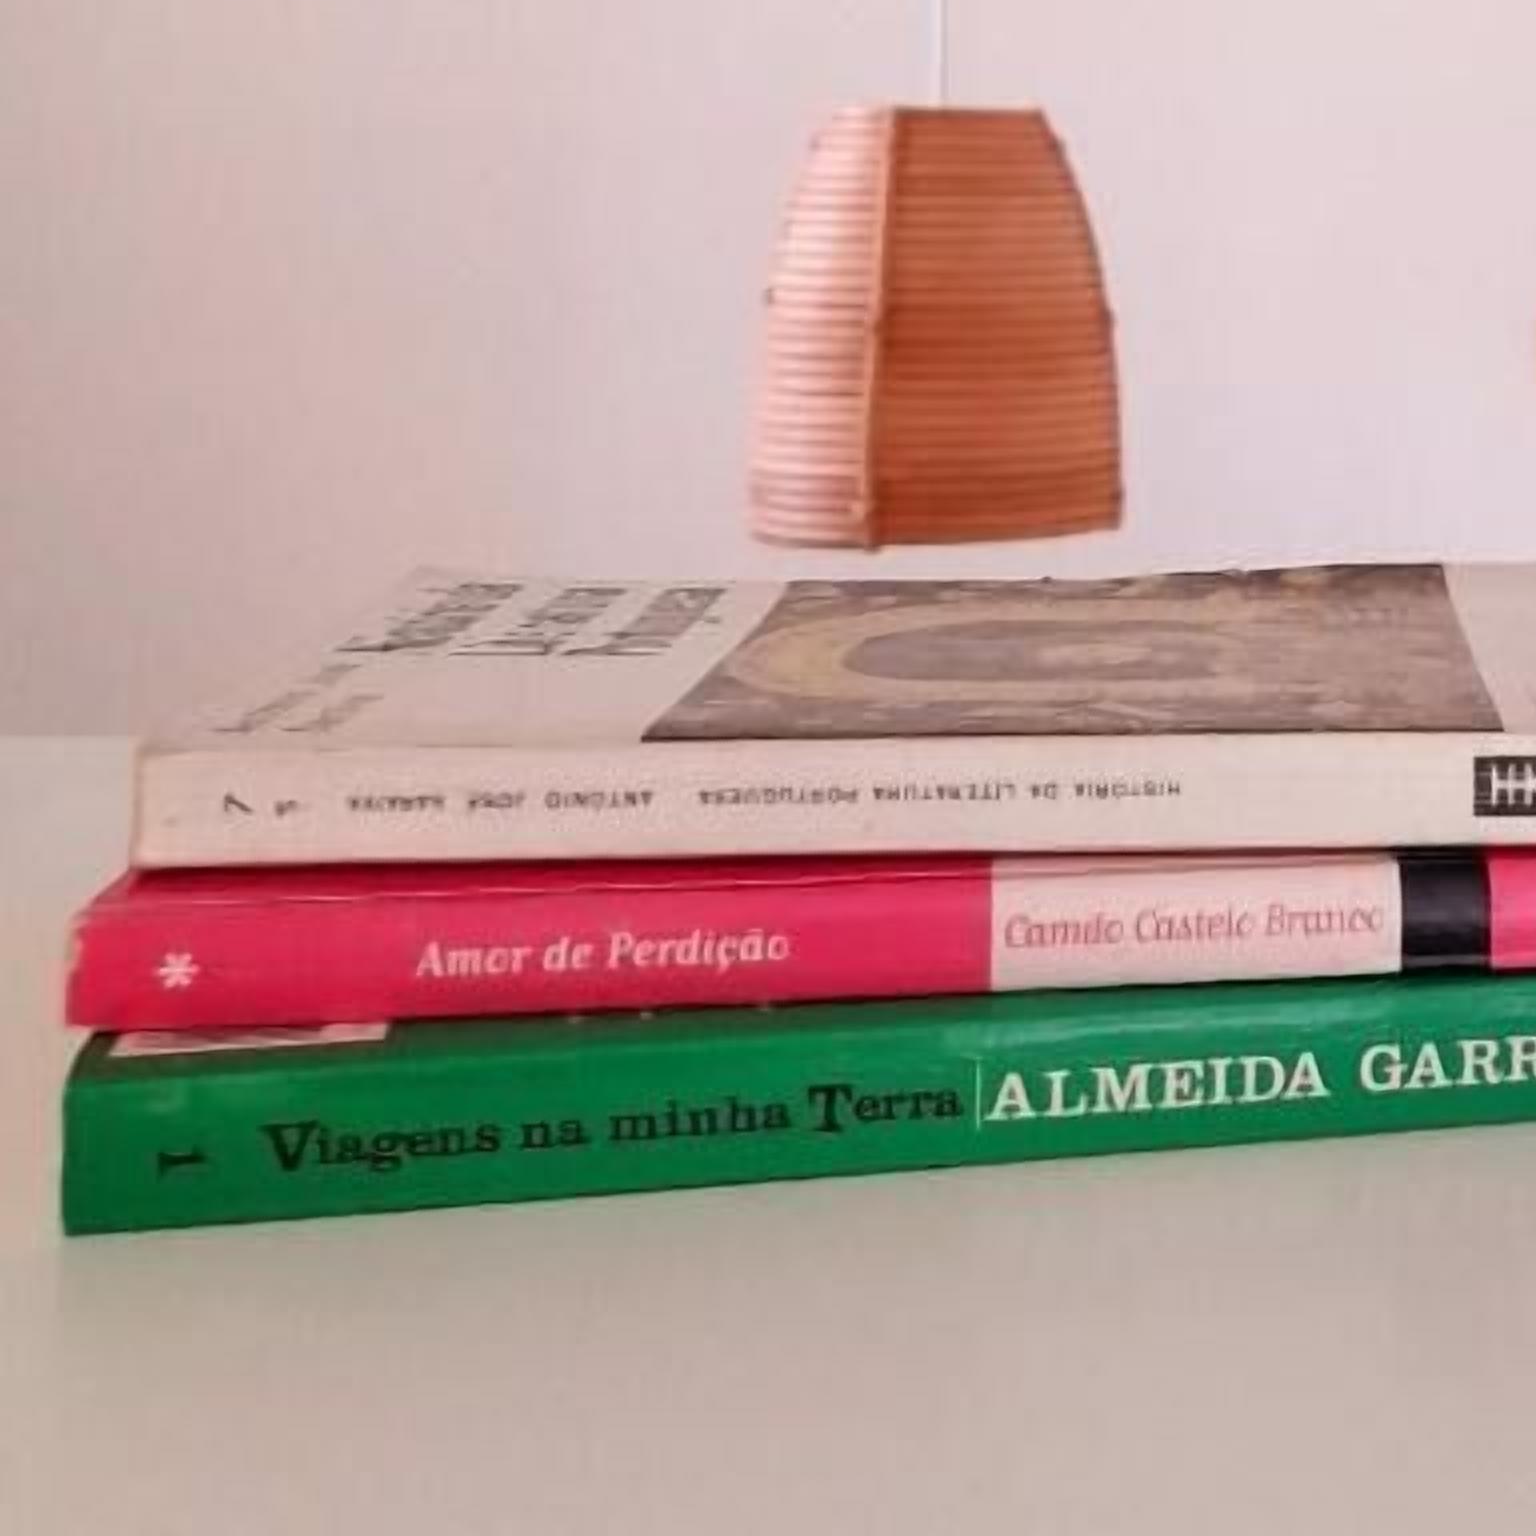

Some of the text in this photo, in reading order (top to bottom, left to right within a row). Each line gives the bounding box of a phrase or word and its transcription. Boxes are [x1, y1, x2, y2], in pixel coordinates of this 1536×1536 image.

[415, 927, 791, 978] Amor de Perdição
[1003, 901, 1385, 949] Camilo Castelo Branco
[984, 1050, 1330, 1122] ALMEIDA
[262, 1082, 965, 1172] Viagens na minha Terra
